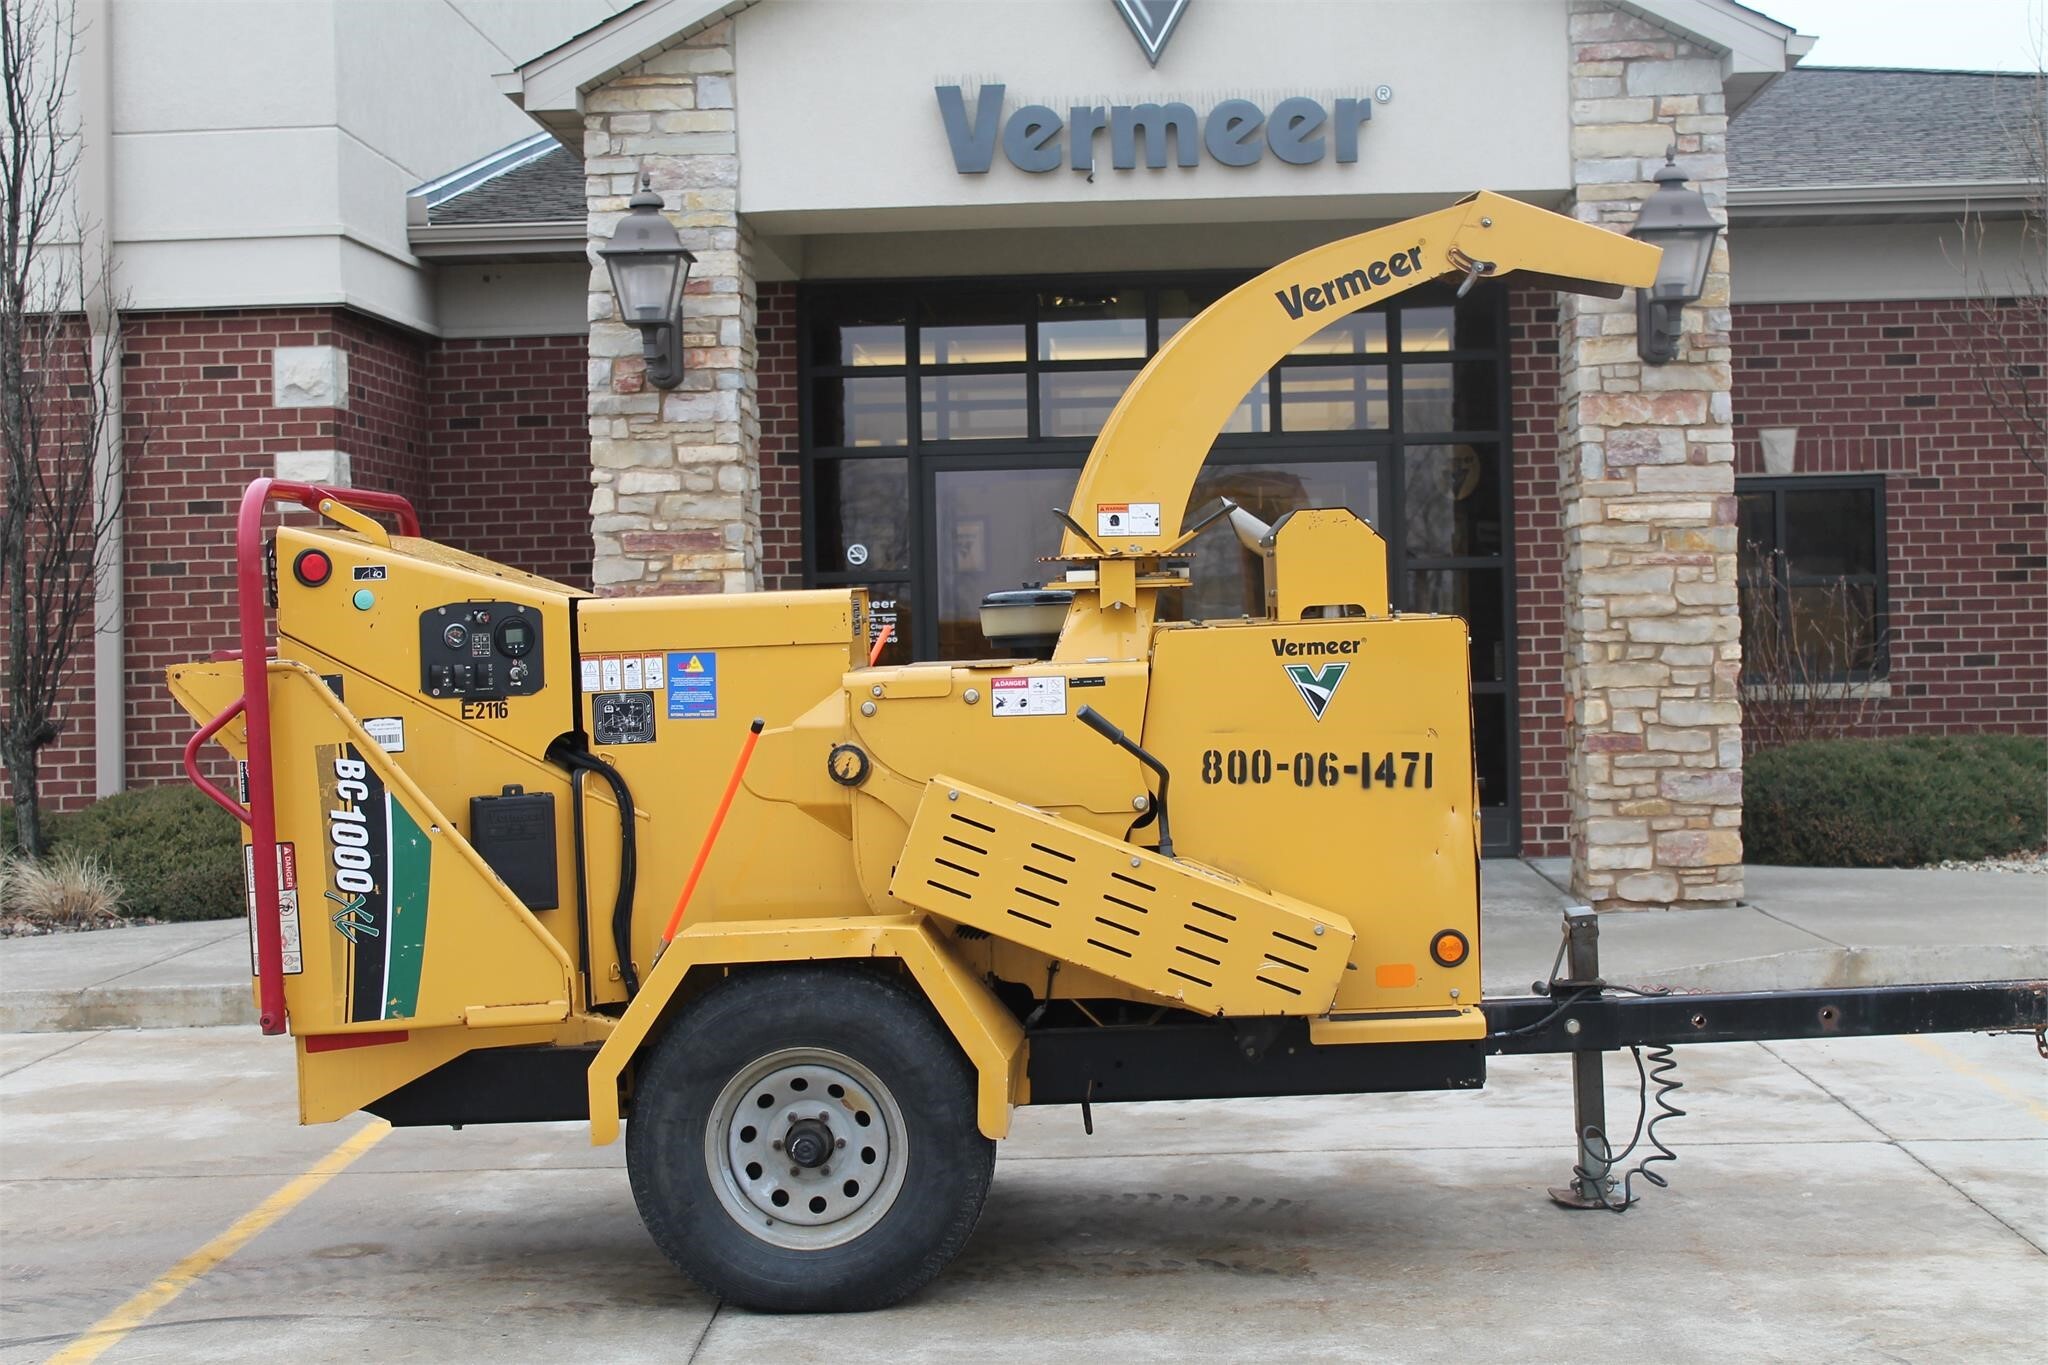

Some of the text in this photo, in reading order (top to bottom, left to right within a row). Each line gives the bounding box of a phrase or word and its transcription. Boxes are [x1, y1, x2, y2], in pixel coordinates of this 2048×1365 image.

[934, 84, 1372, 175] Vermeer
[1274, 245, 1423, 320] Vermeer
[868, 600, 896, 608] eer
[1271, 638, 1361, 656] Vermeer
[1000, 680, 1027, 688] DANGER
[461, 702, 509, 720] E2116
[1202, 749, 1434, 790] 800-06-1471
[283, 855, 294, 889] DANGER
